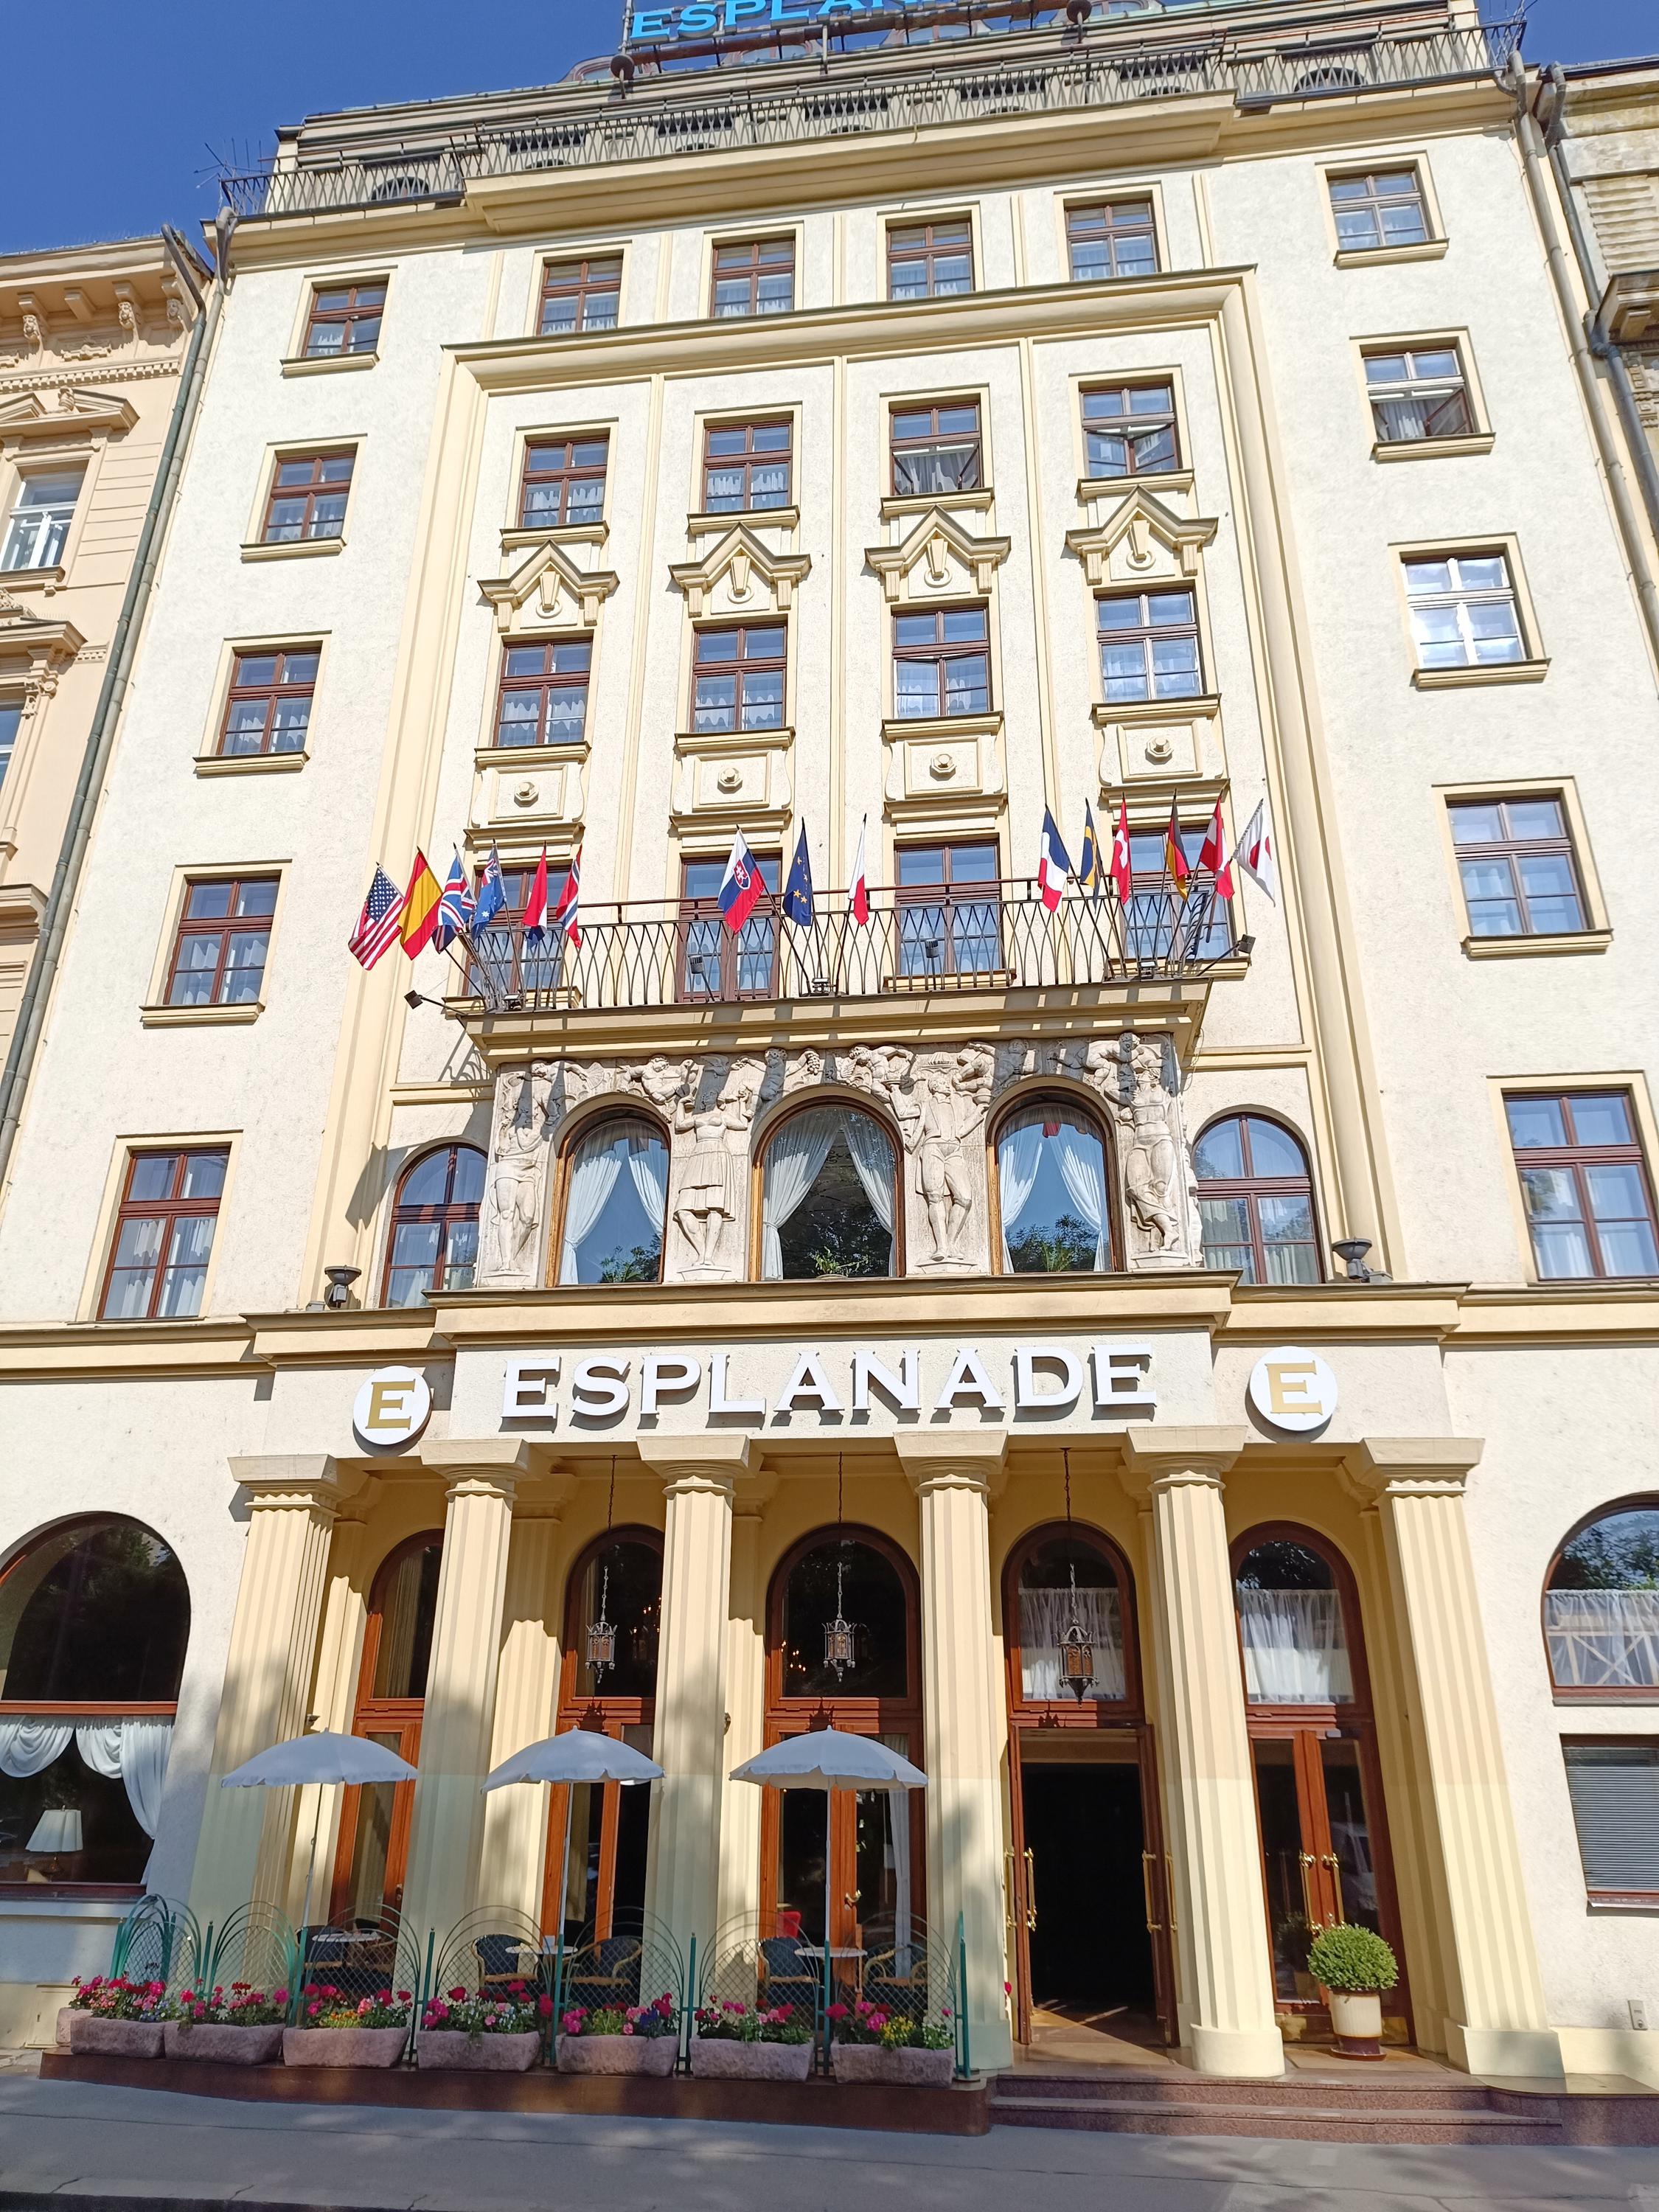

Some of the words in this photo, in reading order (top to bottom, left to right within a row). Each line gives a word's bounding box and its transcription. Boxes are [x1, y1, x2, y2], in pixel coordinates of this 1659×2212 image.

[365, 1378, 417, 1430] E
[501, 1343, 1157, 1419] ESPLANADE
[1264, 1360, 1324, 1416] E
